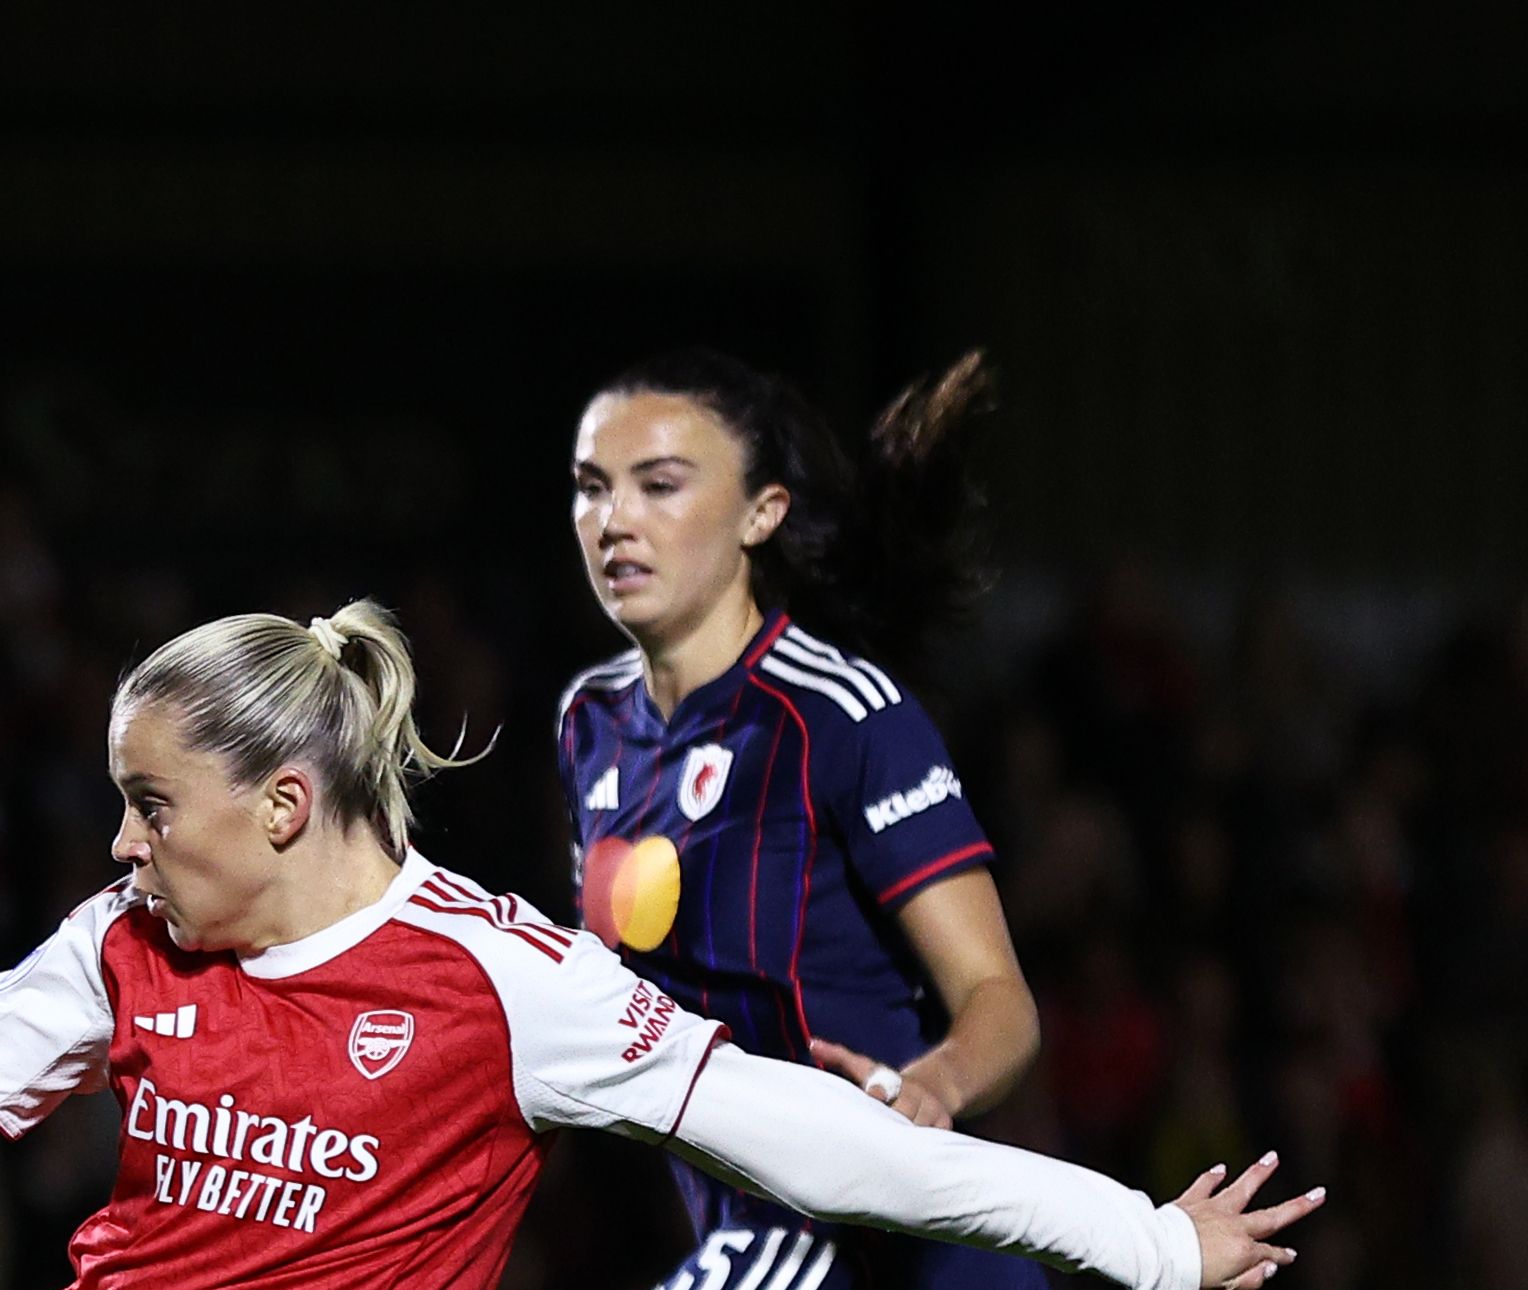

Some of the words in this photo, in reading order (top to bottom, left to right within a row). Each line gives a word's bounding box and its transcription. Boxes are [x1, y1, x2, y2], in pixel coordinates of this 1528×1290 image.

[361, 1022, 405, 1035] Arsenal
[618, 980, 653, 1028] VISIT
[128, 1077, 380, 1182] Emirates
[154, 1154, 202, 1206] FLY
[196, 1165, 326, 1233] BETTER
